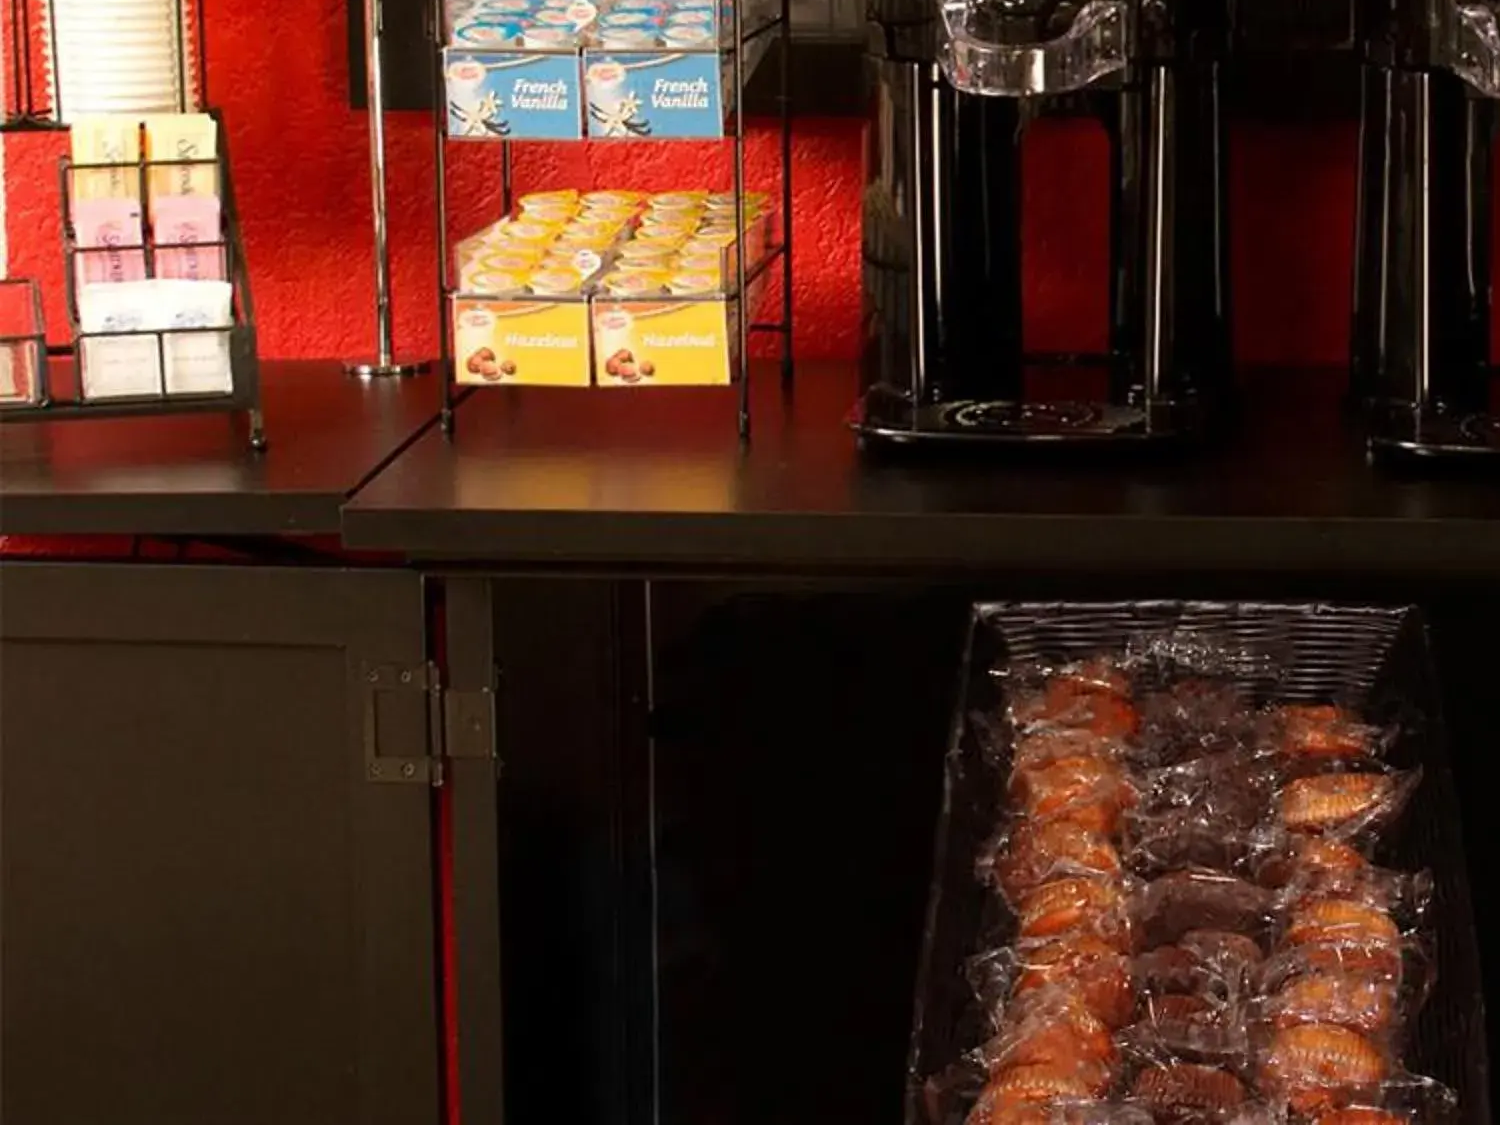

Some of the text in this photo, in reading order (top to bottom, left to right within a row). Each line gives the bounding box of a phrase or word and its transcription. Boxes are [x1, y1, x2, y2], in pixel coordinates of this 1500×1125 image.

[512, 77, 569, 94] French
[653, 77, 709, 94] French
[511, 92, 569, 110] Vanilla
[651, 91, 709, 109] Vanilla
